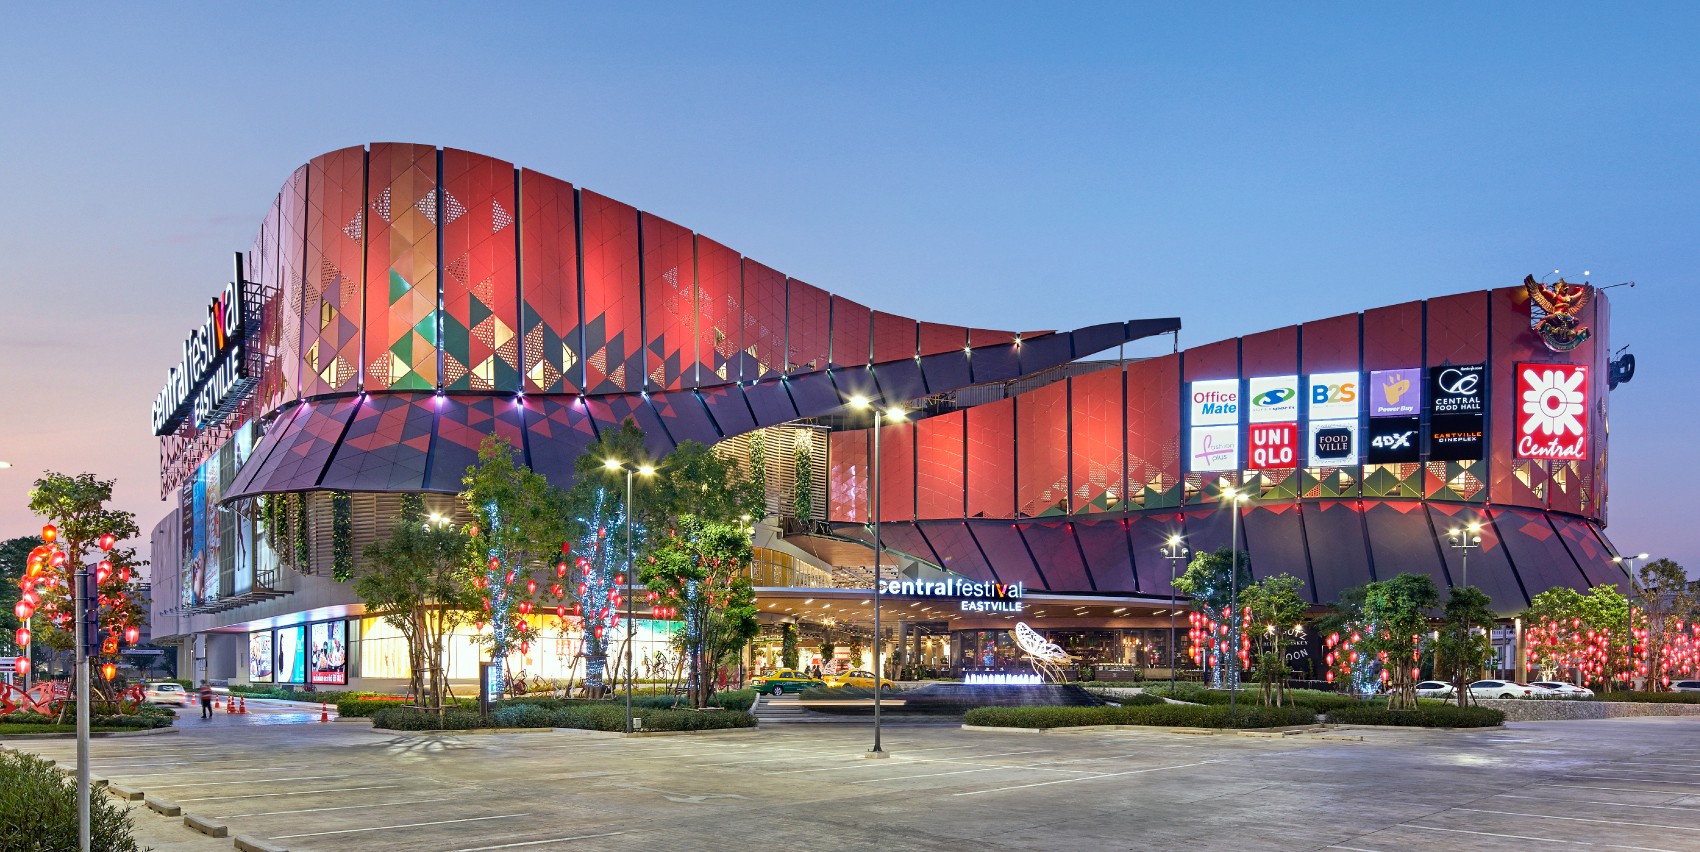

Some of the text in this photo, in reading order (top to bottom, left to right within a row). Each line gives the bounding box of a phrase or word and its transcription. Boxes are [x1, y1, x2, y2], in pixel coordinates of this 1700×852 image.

[194, 345, 240, 426] EASTVILLE
[1193, 391, 1237, 404] Office
[1312, 383, 1356, 404] B2S
[1435, 397, 1481, 405] CENTRAL
[1201, 403, 1237, 414] Mate
[1254, 428, 1289, 445] UNI
[1319, 435, 1348, 443] FOOD
[1372, 431, 1413, 449] 4DX
[1433, 431, 1482, 439] EASTVILLE
[1195, 435, 1235, 466] fashion
[1318, 442, 1348, 451] VILLE
[1518, 435, 1584, 458] Central
[1212, 454, 1228, 462] plus
[1254, 447, 1293, 467] QLO
[961, 600, 1023, 612] EASTVILLE
